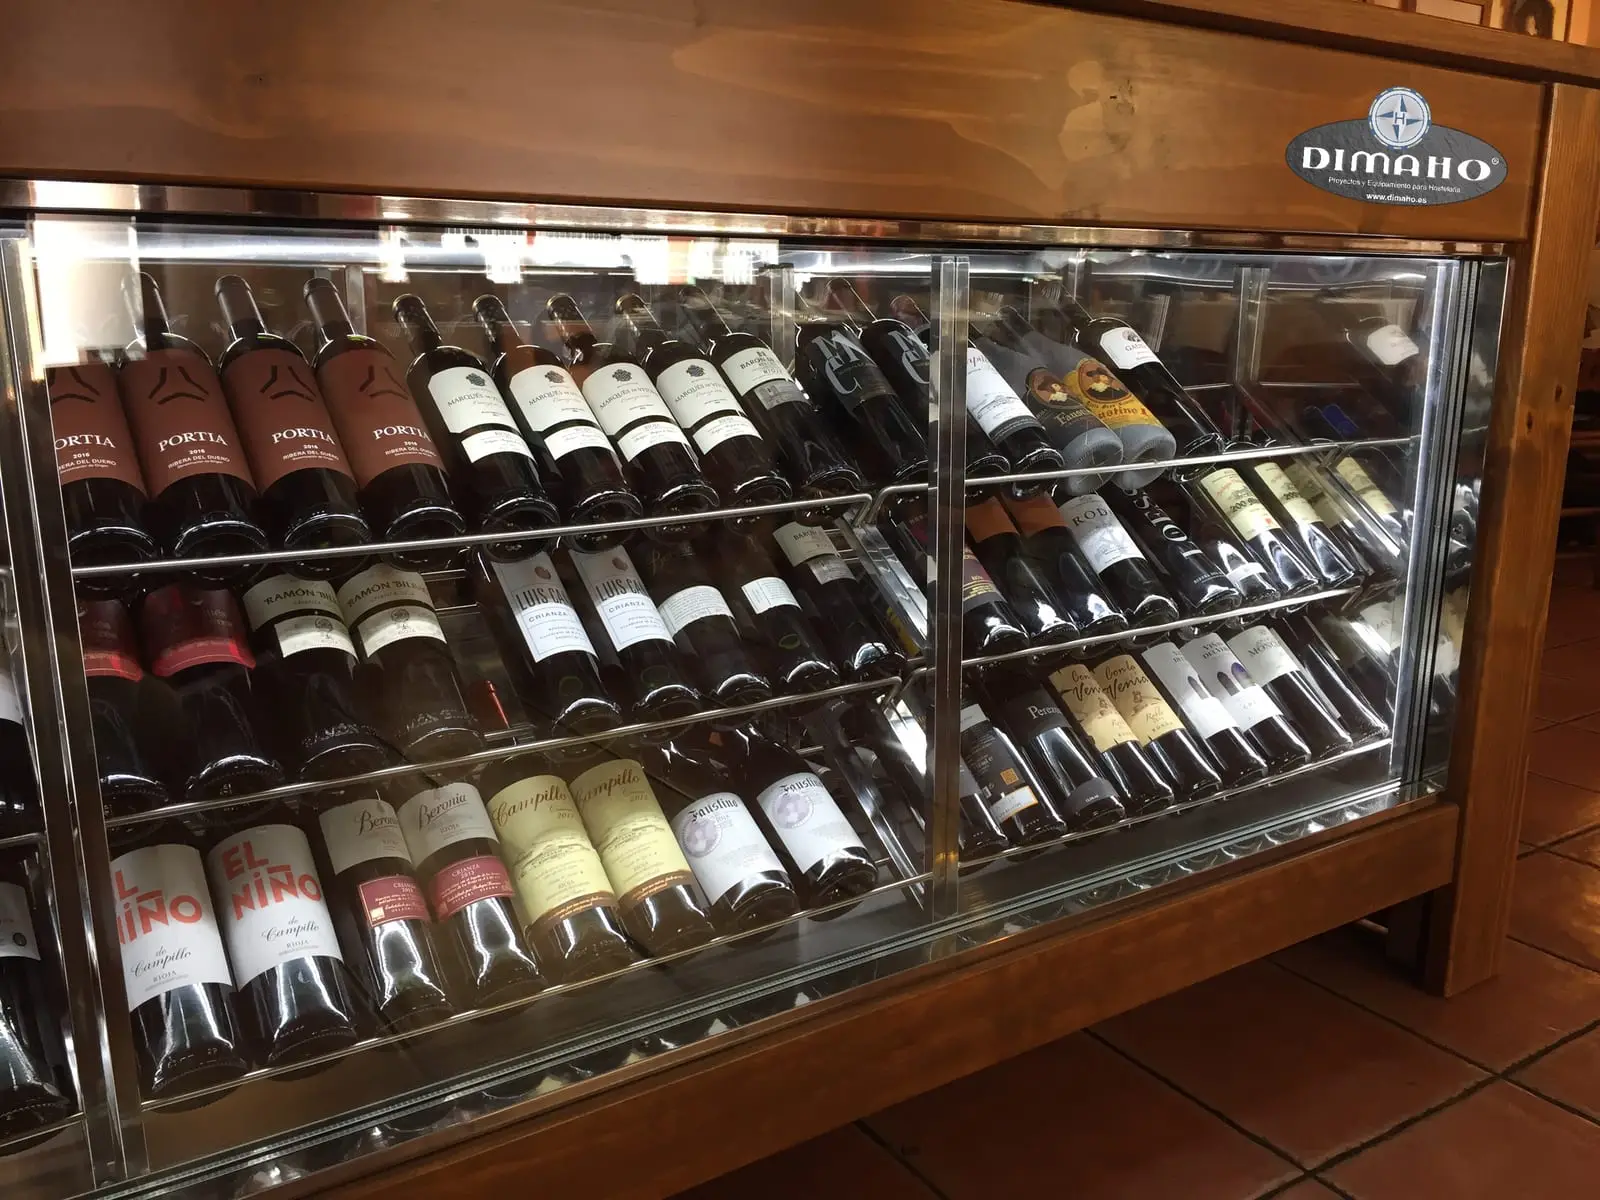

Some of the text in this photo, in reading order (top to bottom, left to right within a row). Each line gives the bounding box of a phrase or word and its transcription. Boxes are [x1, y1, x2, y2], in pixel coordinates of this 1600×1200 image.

[1302, 146, 1491, 181] DIMAHO
[1328, 176, 1361, 187] Proyectos
[1367, 180, 1412, 190] Equipamiento
[1412, 184, 1428, 192] para
[1366, 193, 1428, 204] www.dimaho.es
[158, 431, 229, 452] PORTIA
[272, 427, 336, 445] PORTIA
[373, 425, 433, 442] PORTIA
[167, 457, 192, 469] RIBERA
[516, 587, 549, 611] LUIS
[596, 579, 628, 602] LUIS
[608, 601, 646, 613] CRIANZA
[528, 611, 569, 623] CRIANZA
[573, 767, 641, 809] Campillo
[418, 792, 467, 832] Beronia
[492, 785, 567, 826] Campillo
[688, 798, 739, 823] Faustino
[222, 840, 269, 880] EL
[451, 863, 480, 877] CRIANZA
[287, 915, 299, 925] de
[262, 923, 320, 943] Campillo
[155, 945, 167, 958] de
[286, 939, 310, 949] RIOJA
[131, 946, 192, 977] Campillo
[152, 971, 177, 983] RIOJA
